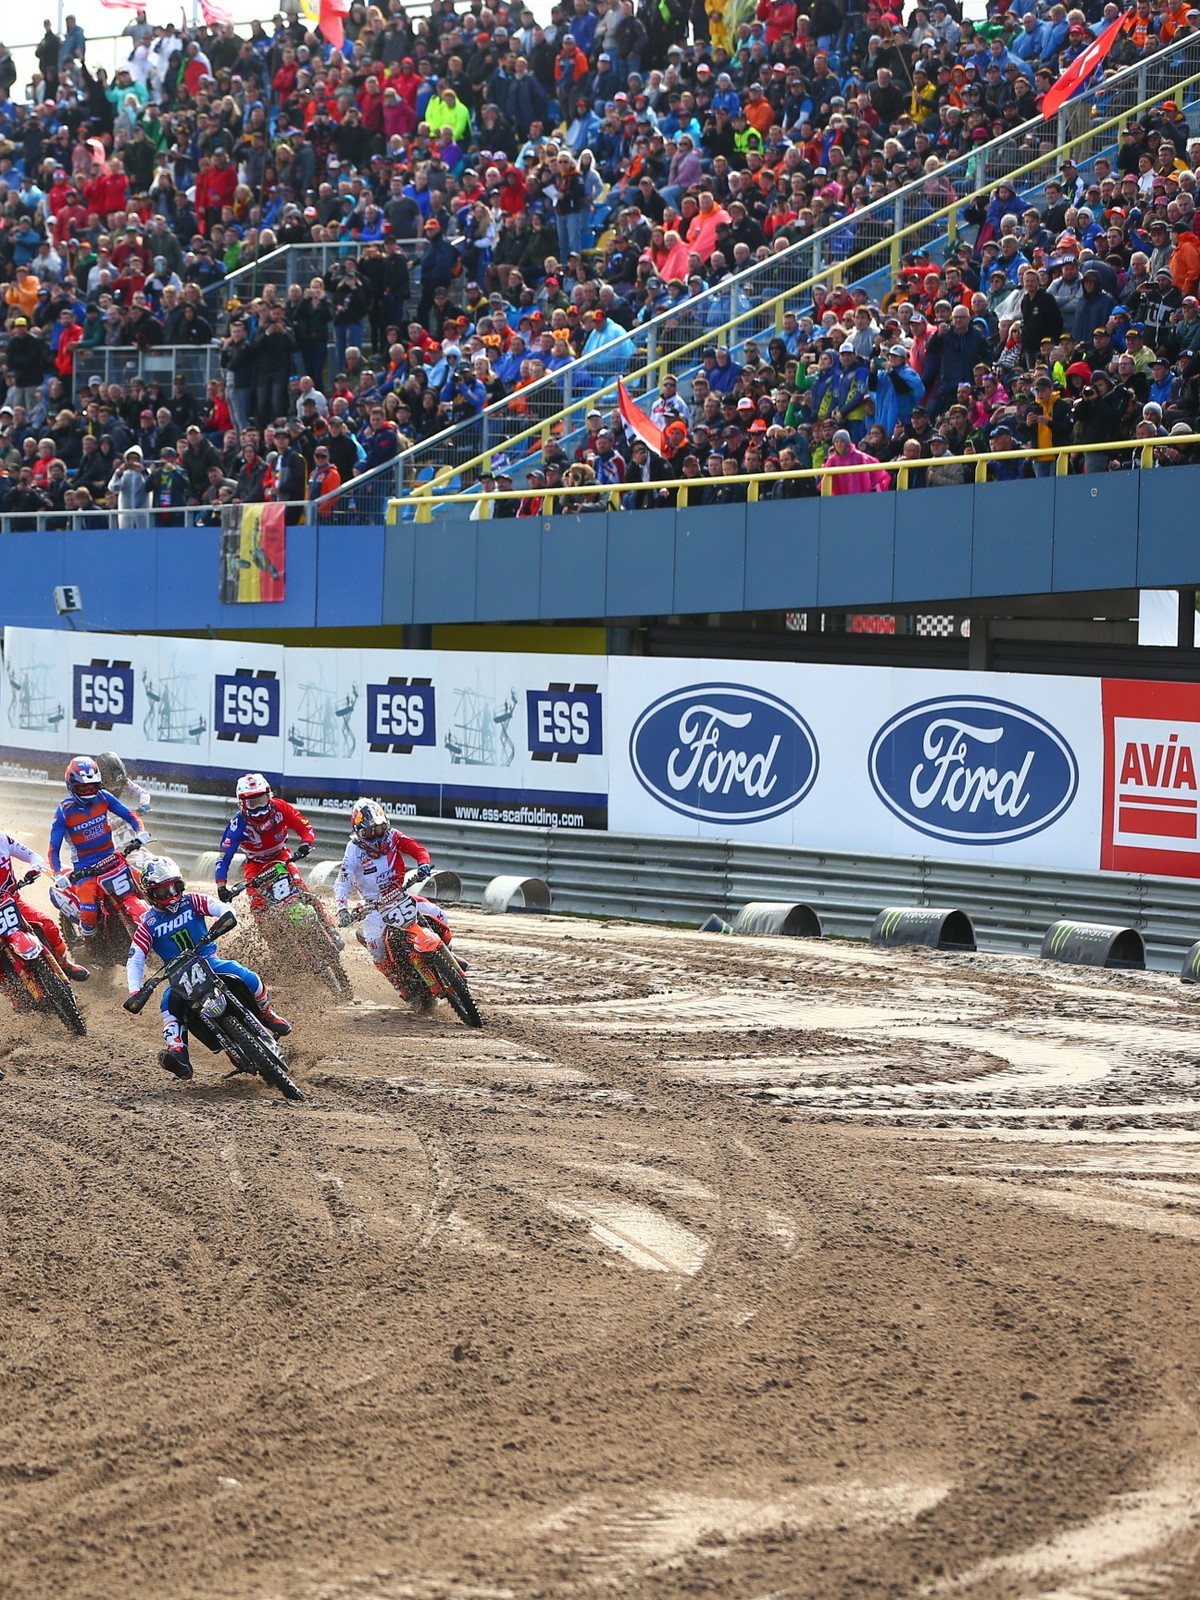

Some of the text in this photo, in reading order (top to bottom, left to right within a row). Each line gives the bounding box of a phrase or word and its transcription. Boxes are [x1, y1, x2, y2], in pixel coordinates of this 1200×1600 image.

[80, 674, 124, 715] ESS
[223, 684, 270, 726] ESS
[376, 693, 424, 737] ESS
[537, 700, 590, 744] ESS
[666, 704, 781, 799] Ford
[909, 718, 1036, 818] Ford
[1120, 734, 1198, 790] AVIA
[73, 814, 107, 832] HONDA
[454, 806, 584, 828] www.ess-scaffolding.com
[111, 872, 131, 896] 5
[272, 878, 291, 900] 8
[153, 909, 194, 938] THOR
[387, 899, 417, 927] 35
[178, 962, 207, 998] 14
